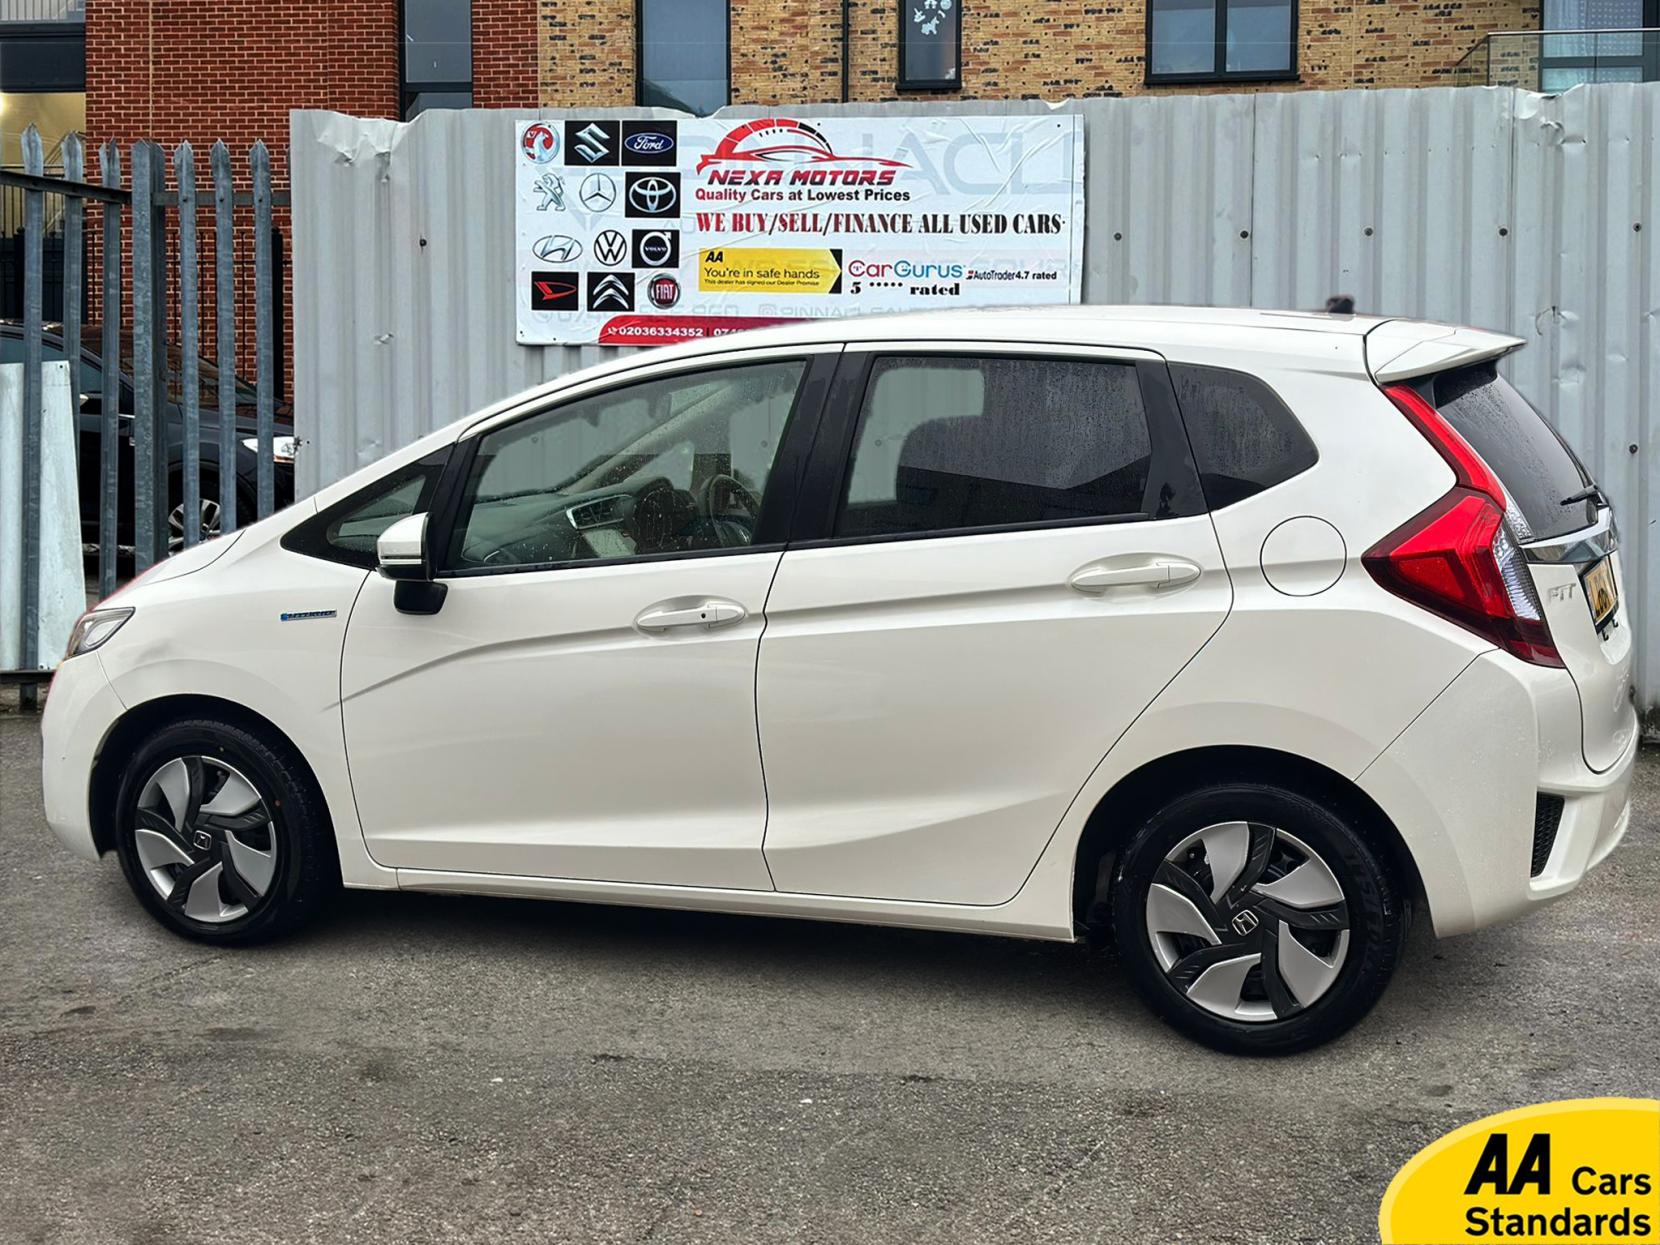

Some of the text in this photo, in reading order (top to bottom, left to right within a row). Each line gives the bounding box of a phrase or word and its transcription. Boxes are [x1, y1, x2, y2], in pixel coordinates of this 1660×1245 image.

[634, 136, 664, 150] Ford
[707, 169, 896, 186] NEXA MOTORS
[695, 188, 911, 203] Quality Cars at Lowest Prices
[696, 212, 726, 232] WE
[918, 213, 954, 234] ALL
[959, 213, 1007, 234] USED
[1012, 213, 1062, 234] CARS
[705, 251, 724, 263] AA
[704, 267, 820, 279] You're in safe hands
[848, 260, 963, 278] CarGurus
[1032, 271, 1057, 280] rated
[656, 285, 674, 299] FIAT
[850, 281, 960, 296] 5 rated
[619, 327, 703, 336] 02036334352
